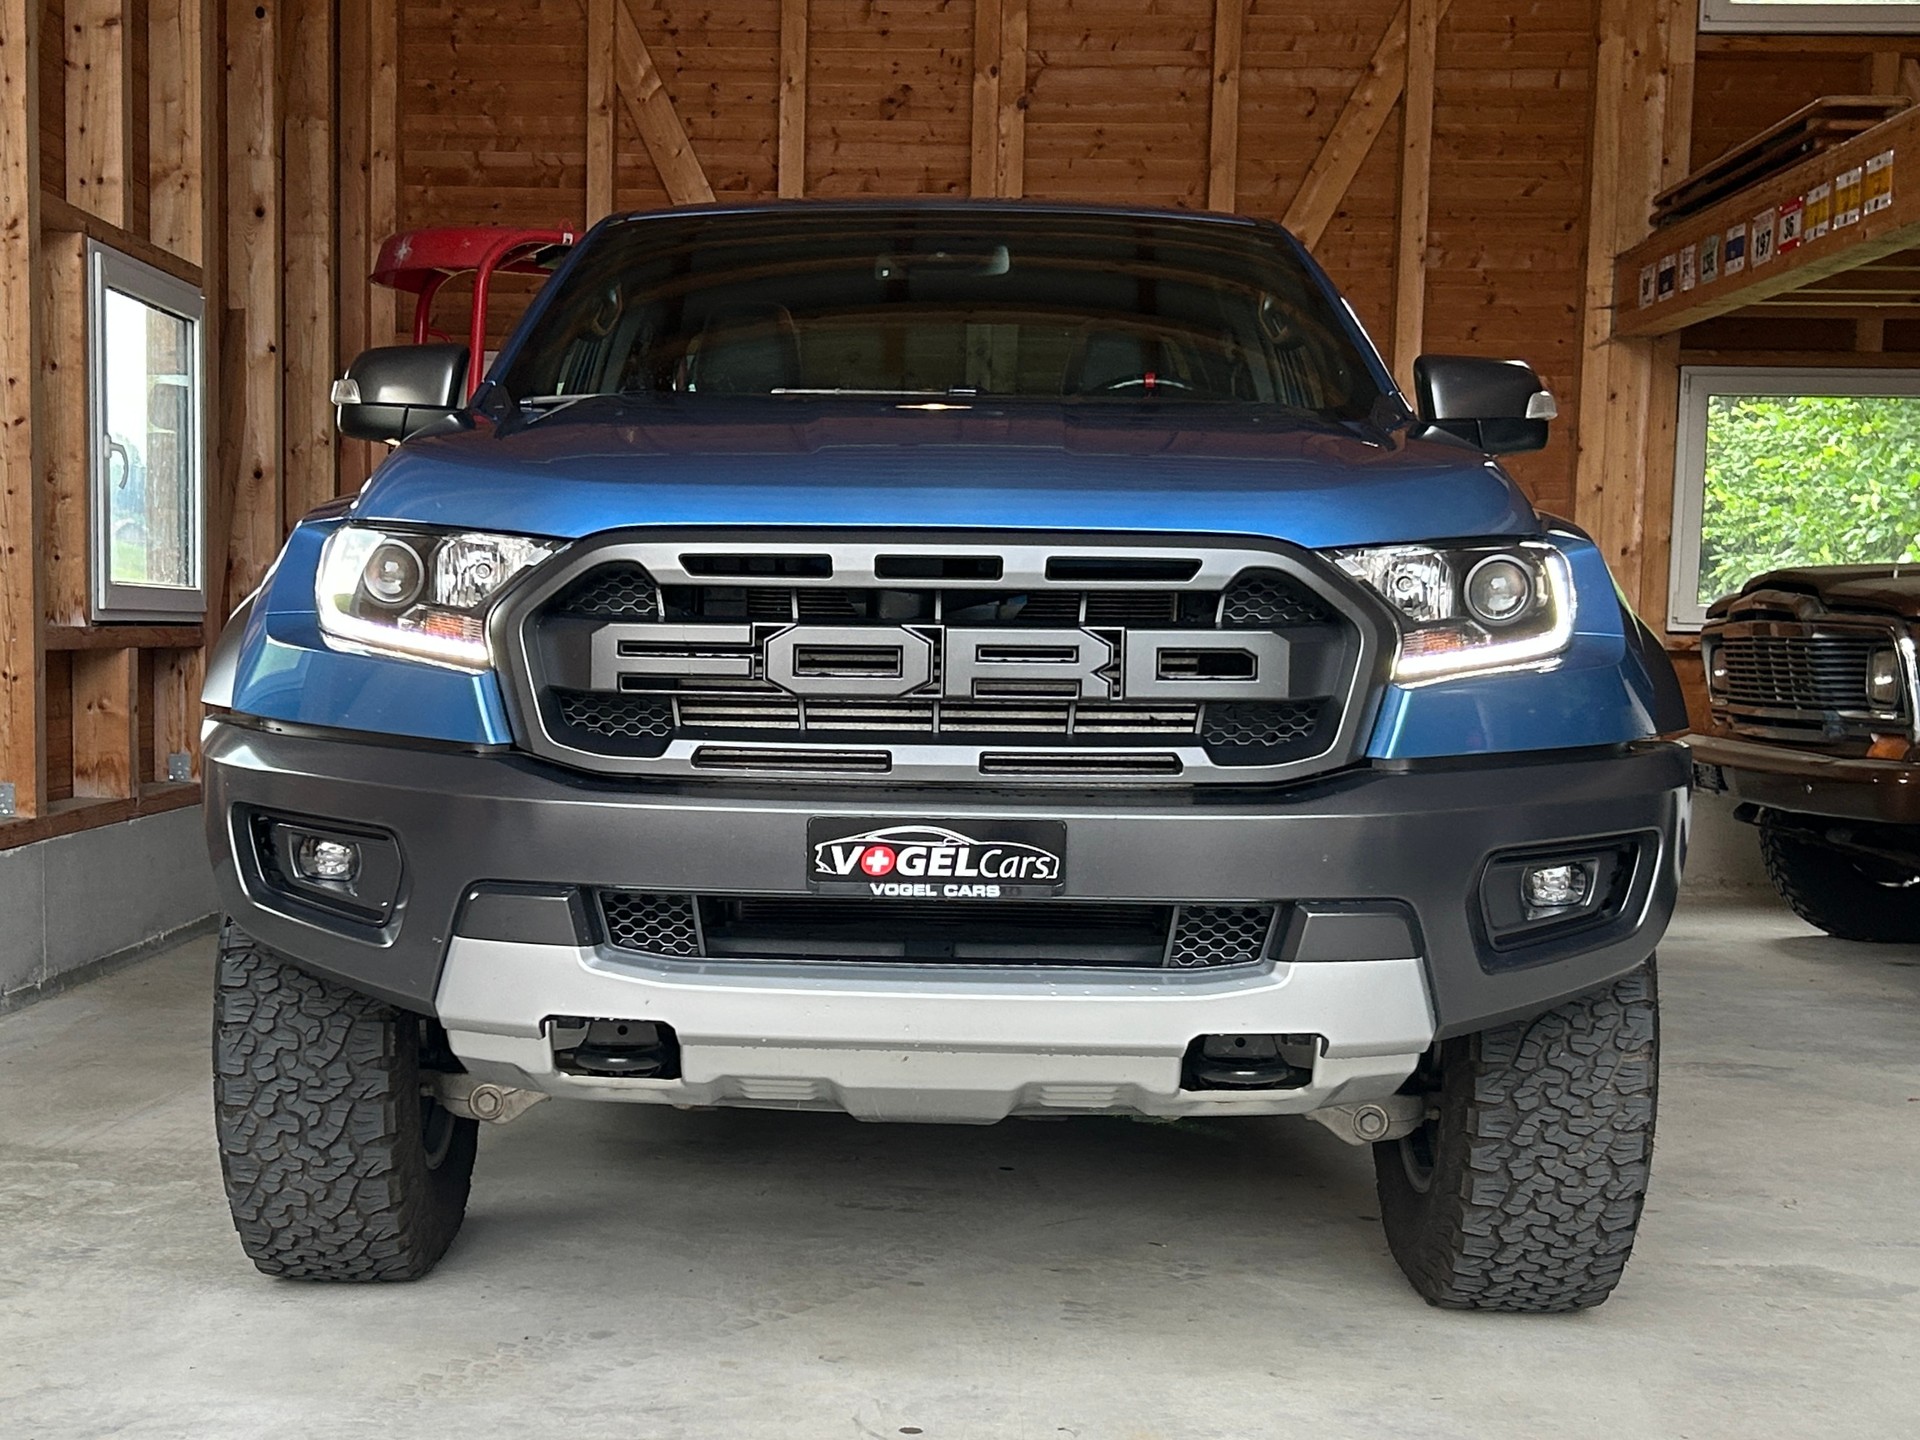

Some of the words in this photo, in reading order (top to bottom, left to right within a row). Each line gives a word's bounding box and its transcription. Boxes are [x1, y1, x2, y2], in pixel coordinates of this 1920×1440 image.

[1755, 230, 1772, 258] 197
[590, 623, 1290, 700] FORD
[870, 883, 938, 896] VOGEL
[944, 884, 1001, 897] CARS
